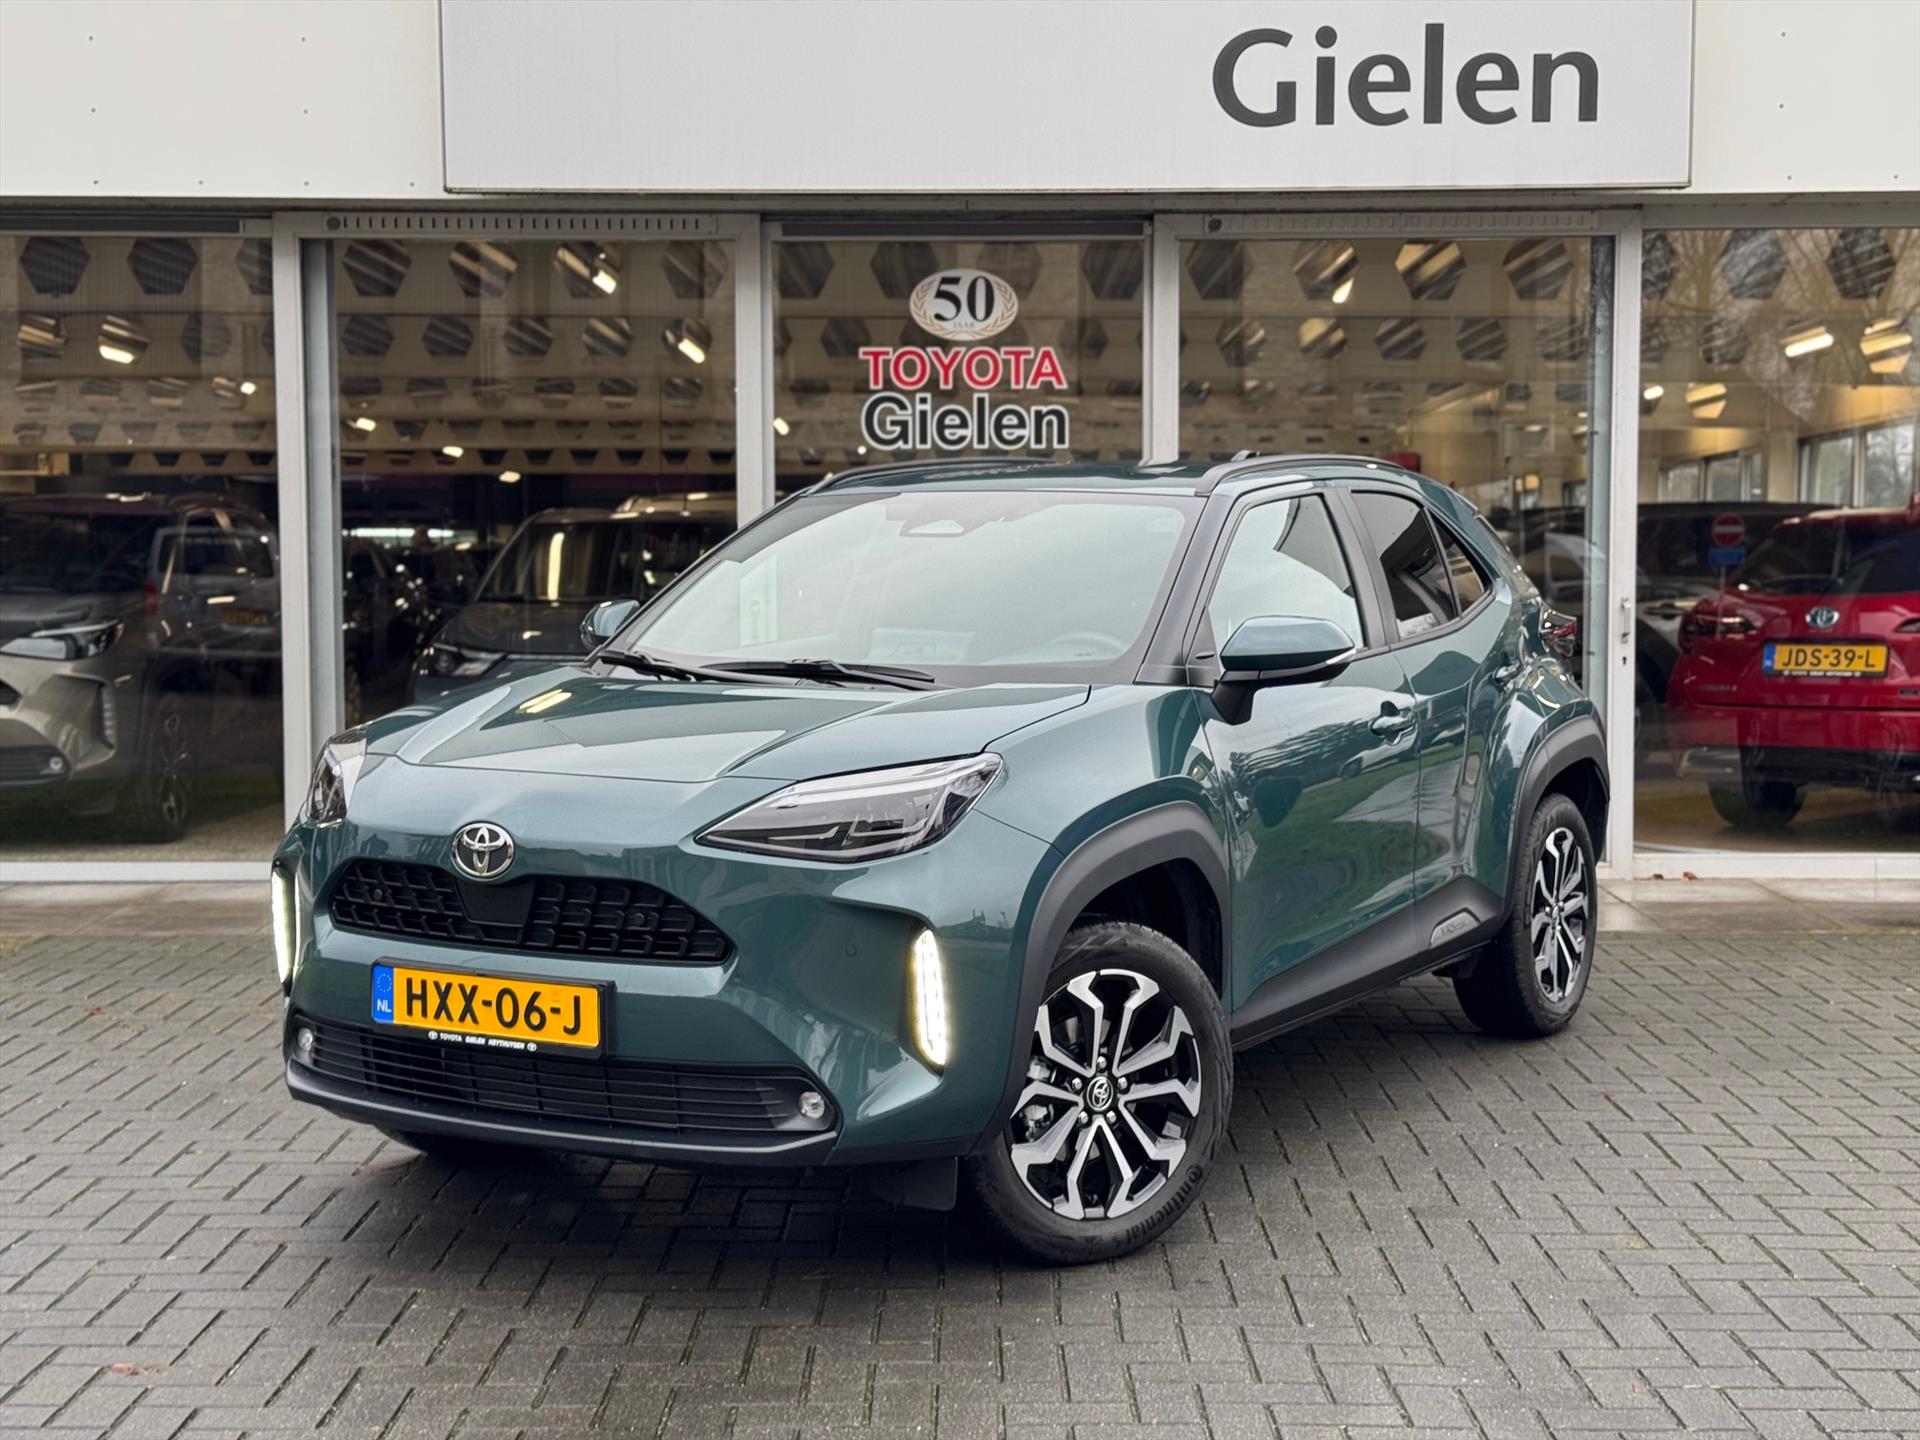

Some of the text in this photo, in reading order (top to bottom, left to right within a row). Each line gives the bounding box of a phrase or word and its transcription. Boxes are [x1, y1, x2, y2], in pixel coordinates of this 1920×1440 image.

[1212, 23, 1599, 128] Gielen
[934, 275, 995, 322] 50
[859, 346, 1068, 390] TOYOTA
[861, 392, 1069, 450] Gielen
[1782, 648, 1876, 668] JDS-39-L
[376, 998, 392, 1014] NL
[406, 977, 581, 1036] HXX-06-J
[440, 1032, 463, 1042] TOYOTA
[1125, 1163, 1204, 1245] Continental
